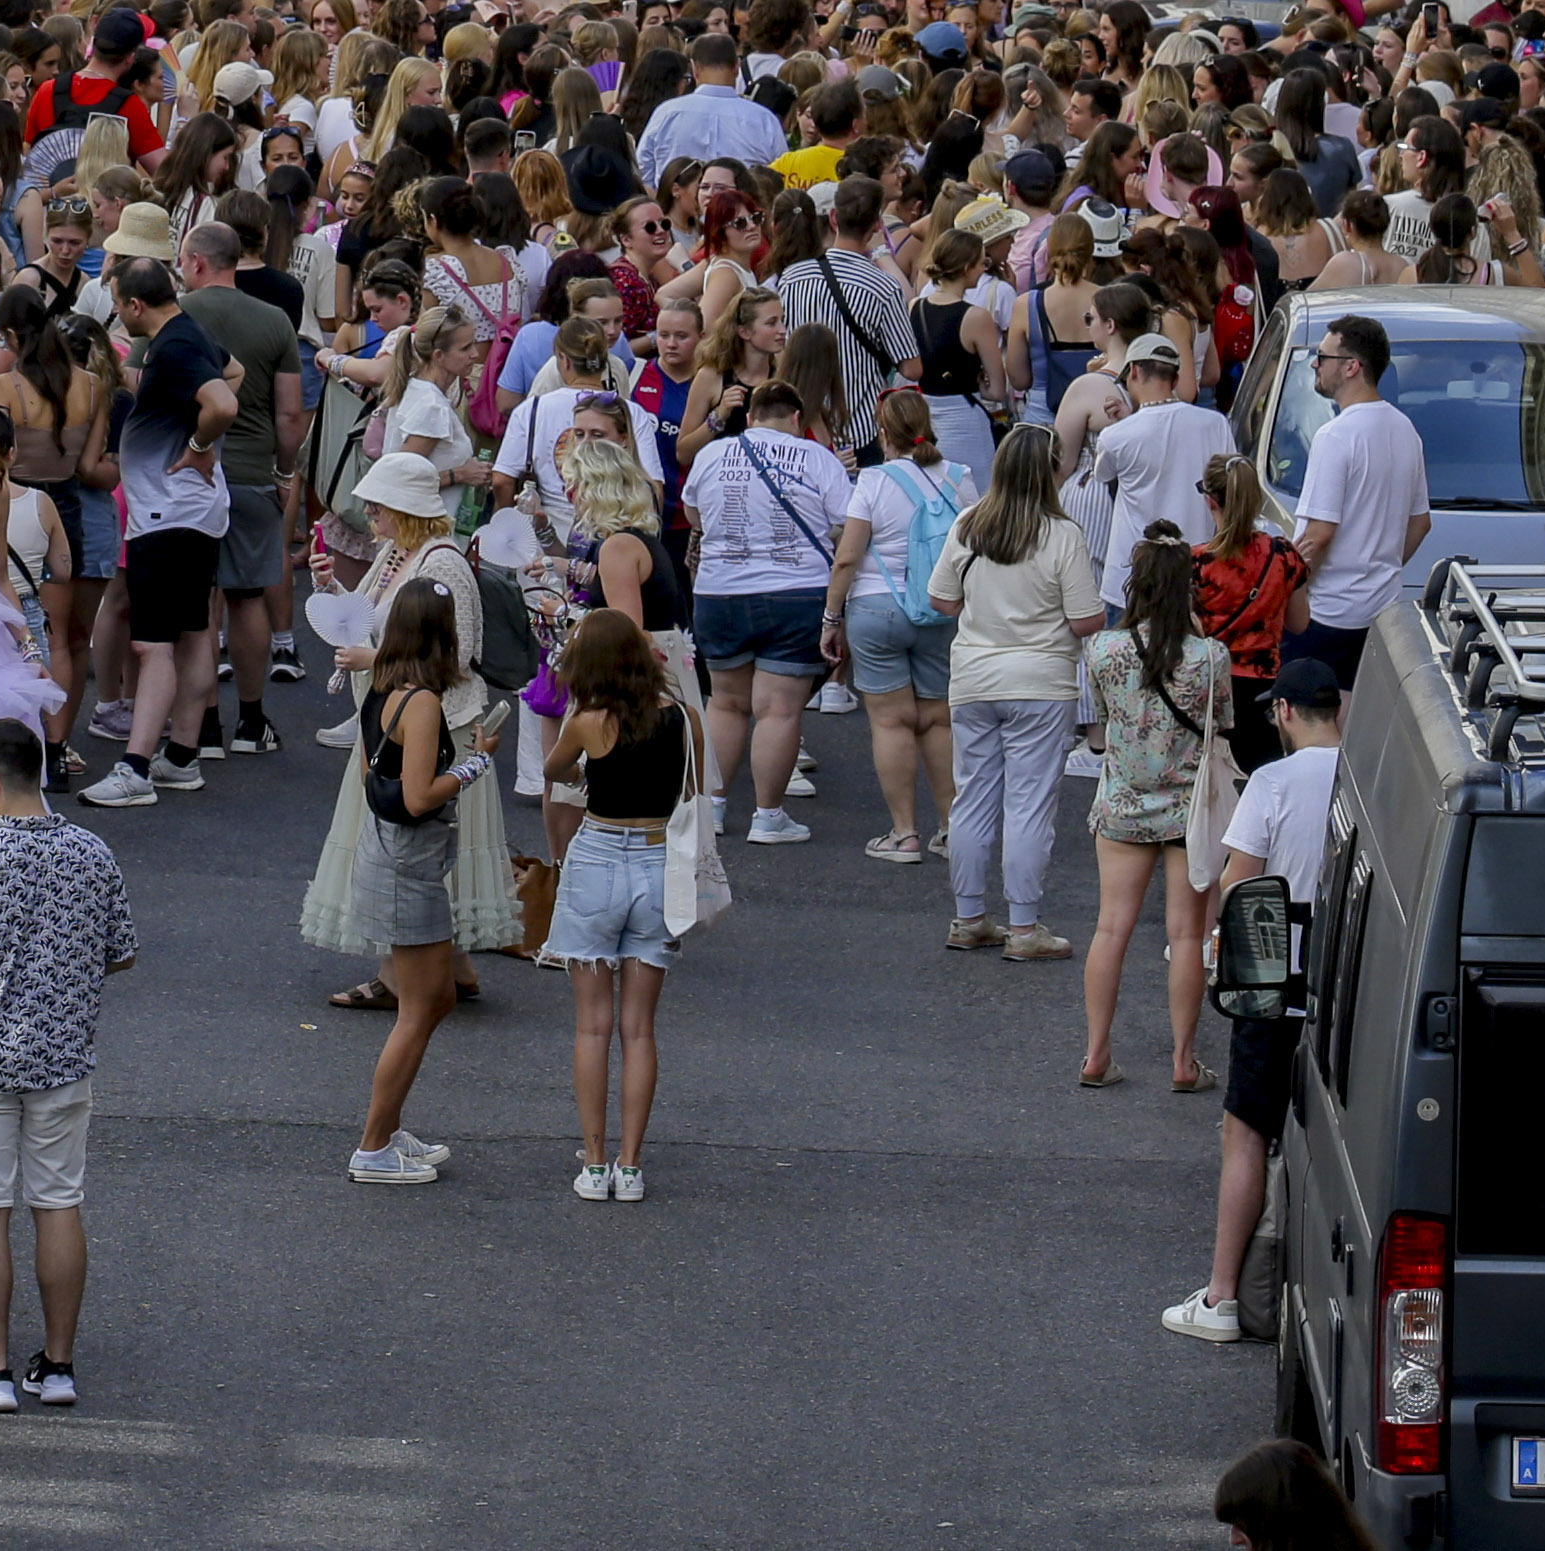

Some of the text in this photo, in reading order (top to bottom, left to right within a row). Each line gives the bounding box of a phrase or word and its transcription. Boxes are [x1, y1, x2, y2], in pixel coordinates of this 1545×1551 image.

[1391, 244, 1418, 257] 2023
[769, 443, 810, 464] SWIFT
[721, 458, 742, 468] THE
[718, 470, 751, 482] 2023
[1522, 1468, 1533, 1479] A
